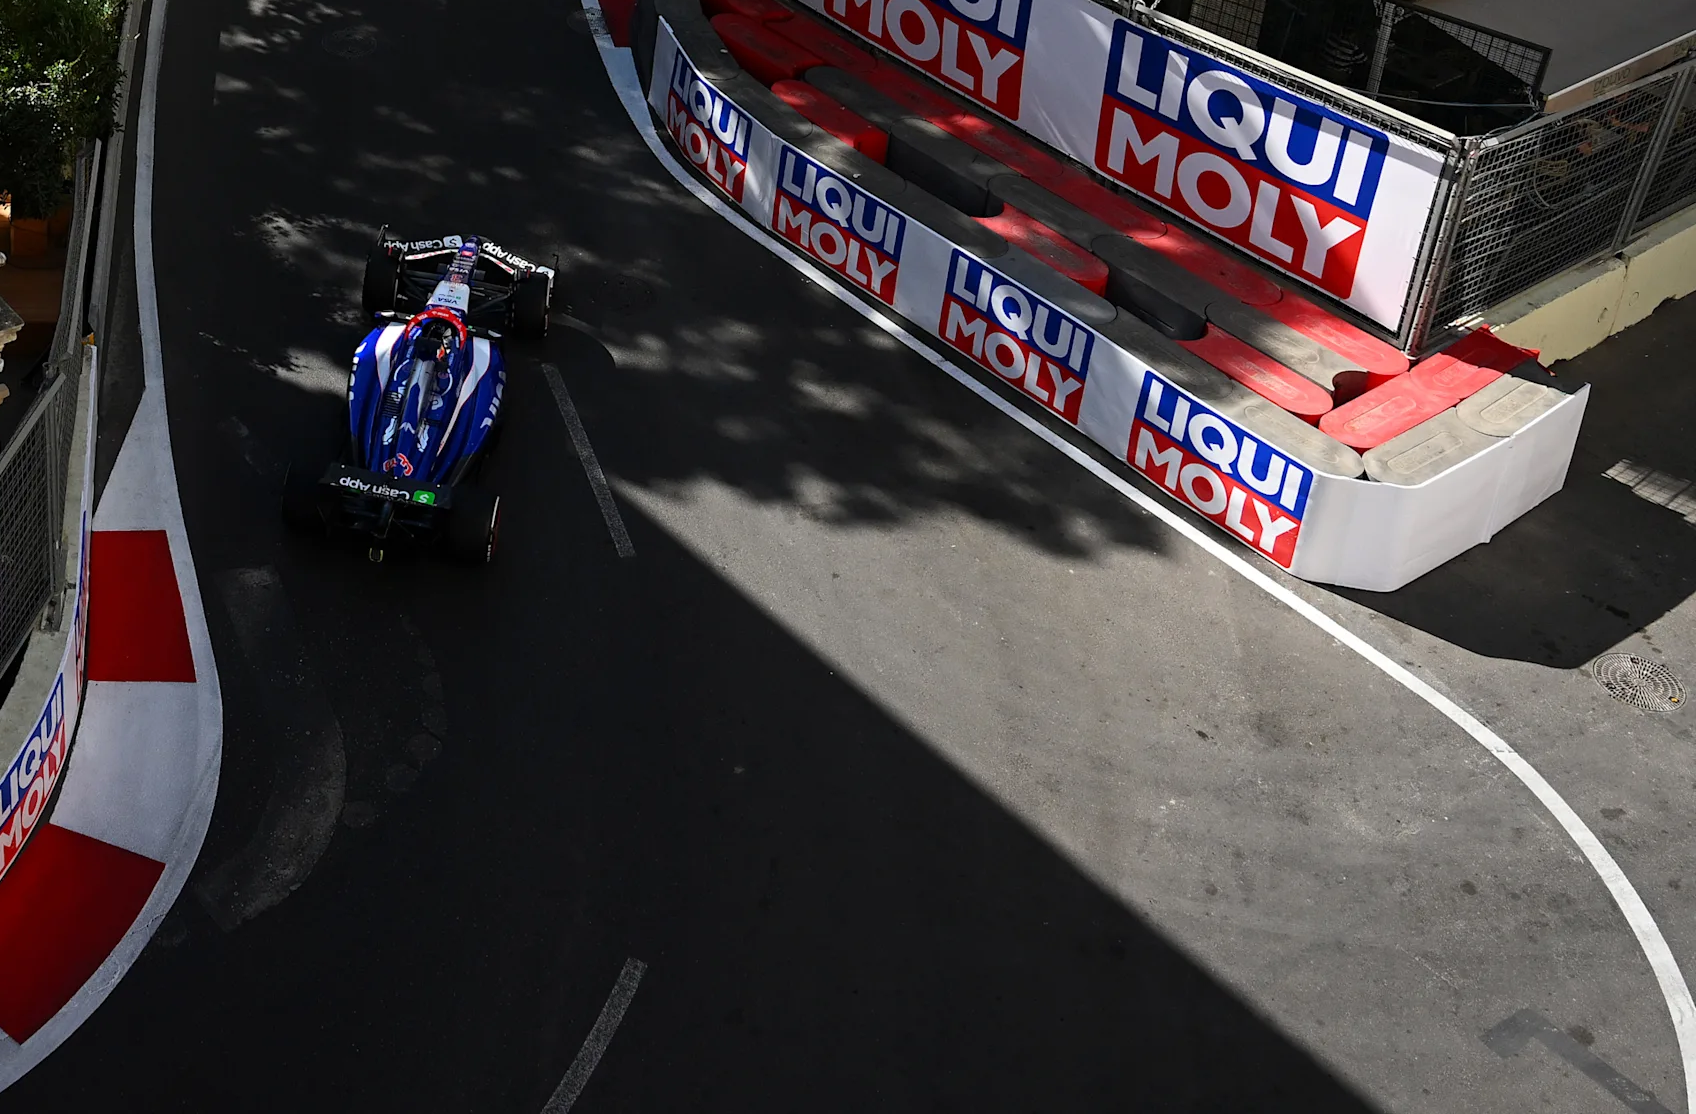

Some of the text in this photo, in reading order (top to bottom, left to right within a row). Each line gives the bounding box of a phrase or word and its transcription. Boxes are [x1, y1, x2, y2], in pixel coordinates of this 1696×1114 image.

[669, 97, 745, 192] MOLY
[672, 53, 750, 157] LIQUI
[1117, 28, 1373, 207] LIQUI
[777, 195, 896, 295] MOLY
[782, 151, 901, 255] LIQUI
[1107, 107, 1362, 279] MOLY
[481, 241, 507, 259] App
[945, 301, 1082, 412] MOLY
[952, 255, 1088, 373] LIQUI
[339, 476, 370, 492] App
[1134, 427, 1298, 555] MOLY
[1143, 378, 1304, 512] LIQUI
